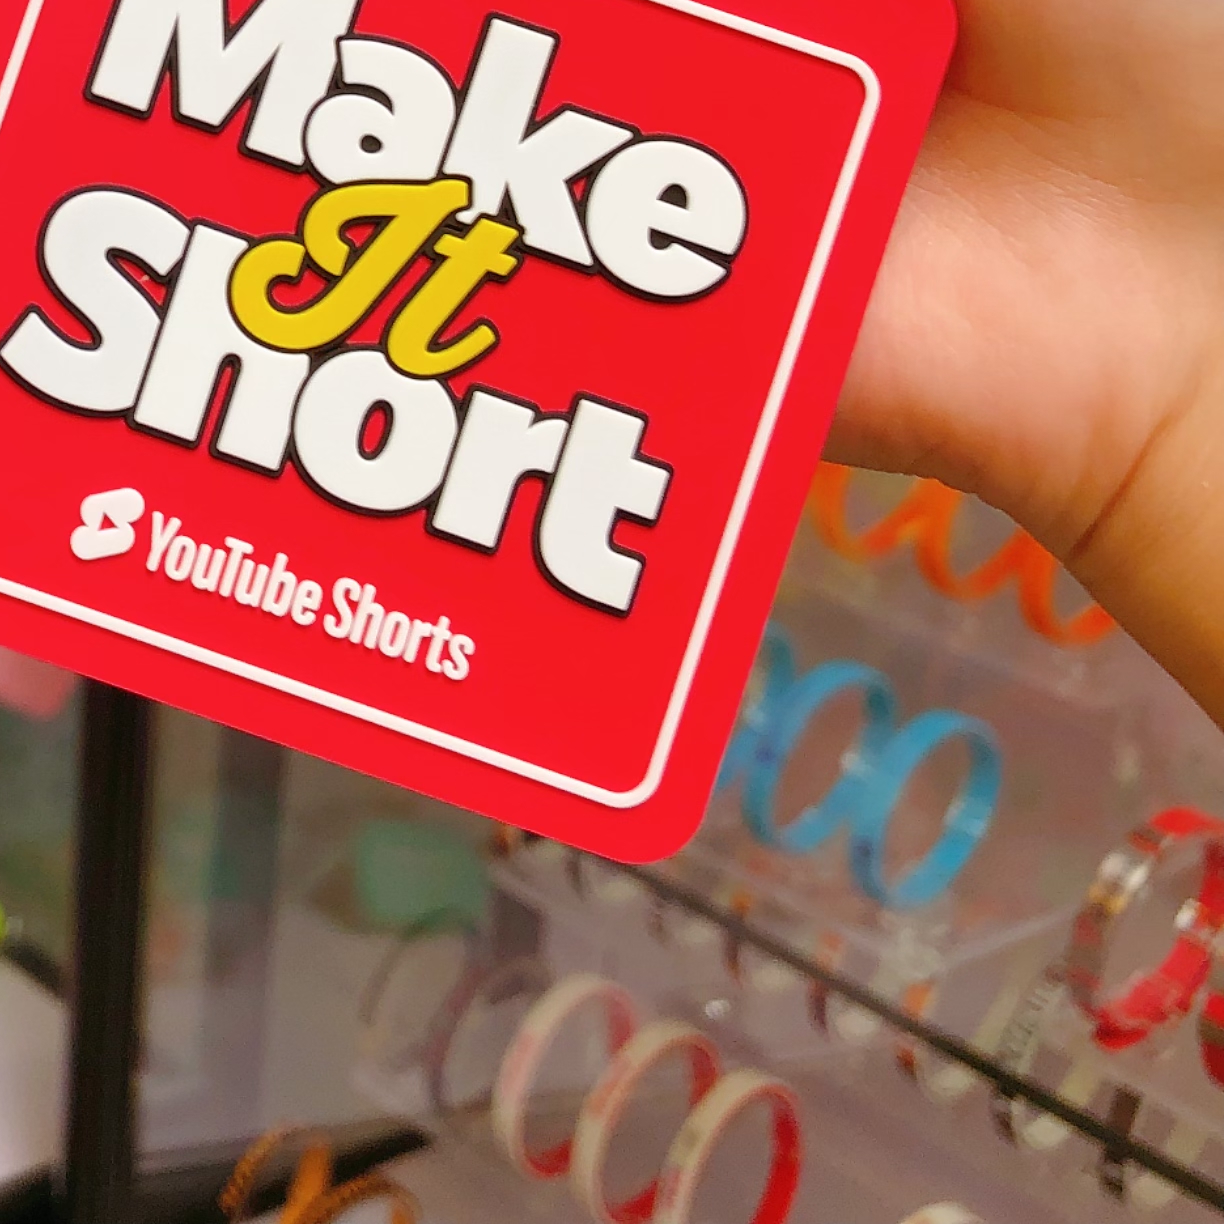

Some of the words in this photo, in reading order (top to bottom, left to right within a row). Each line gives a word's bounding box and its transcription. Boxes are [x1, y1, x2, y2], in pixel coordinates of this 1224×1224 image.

[228, 177, 523, 378] It
[145, 510, 323, 627] YouTube
[323, 576, 475, 681] Shorts
